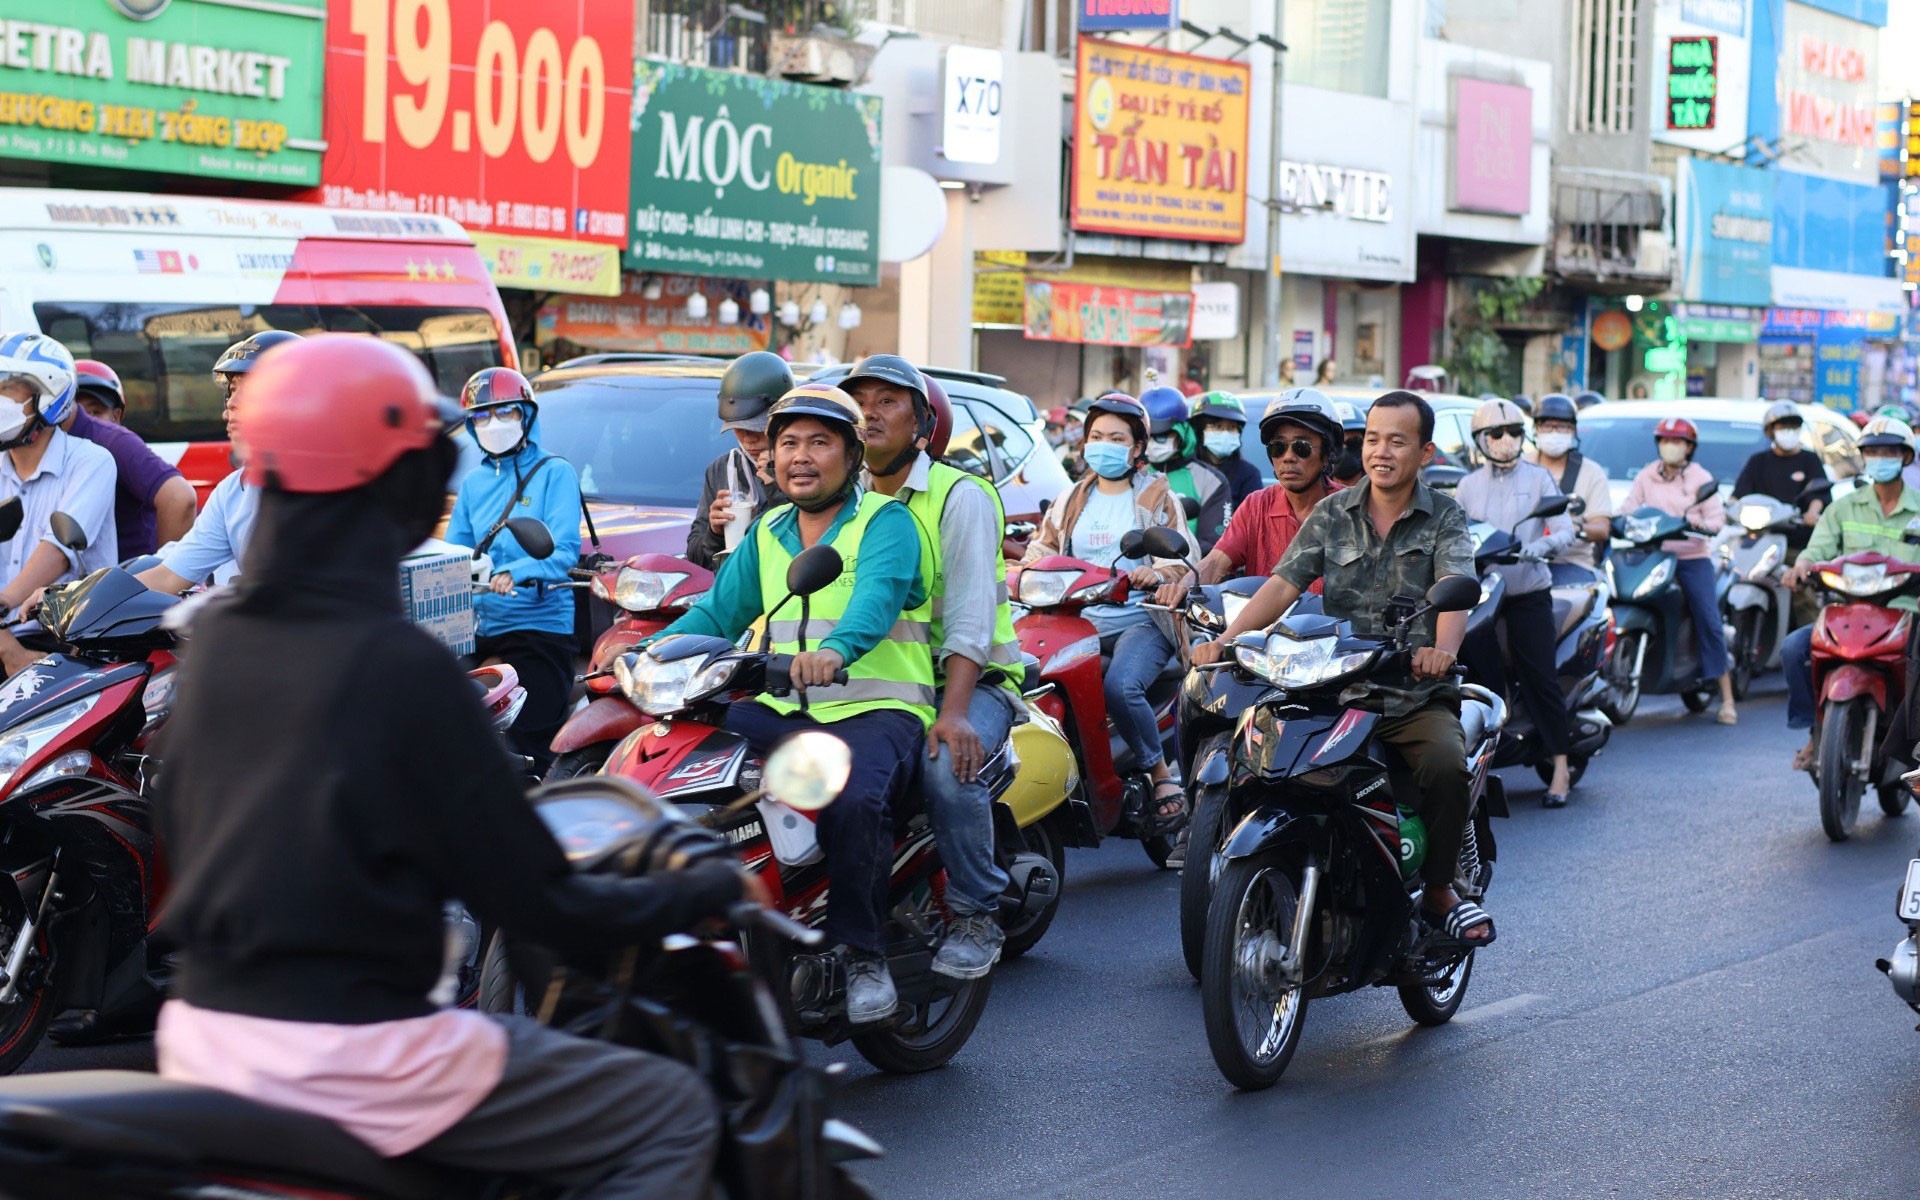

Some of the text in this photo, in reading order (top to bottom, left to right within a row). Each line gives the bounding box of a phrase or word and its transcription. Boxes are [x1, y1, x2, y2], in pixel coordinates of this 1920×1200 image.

[126, 37, 291, 99] MARKET
[351, 0, 605, 169] 19.000
[957, 76, 1001, 116] X70
[99, 103, 155, 146] MẠI
[160, 98, 232, 147] TỔNG
[236, 118, 288, 158] HỢP
[654, 104, 859, 206] MỘC Organic
[1091, 115, 1238, 192] TẤN TÀI
[1280, 159, 1393, 223] ENVIE
[636, 203, 661, 238] MẬT
[661, 210, 688, 236] ONG
[720, 217, 744, 241] LINH
[744, 219, 764, 242] CHI
[826, 227, 869, 251] ORGANIC
[1355, 777, 1386, 800] HONDA
